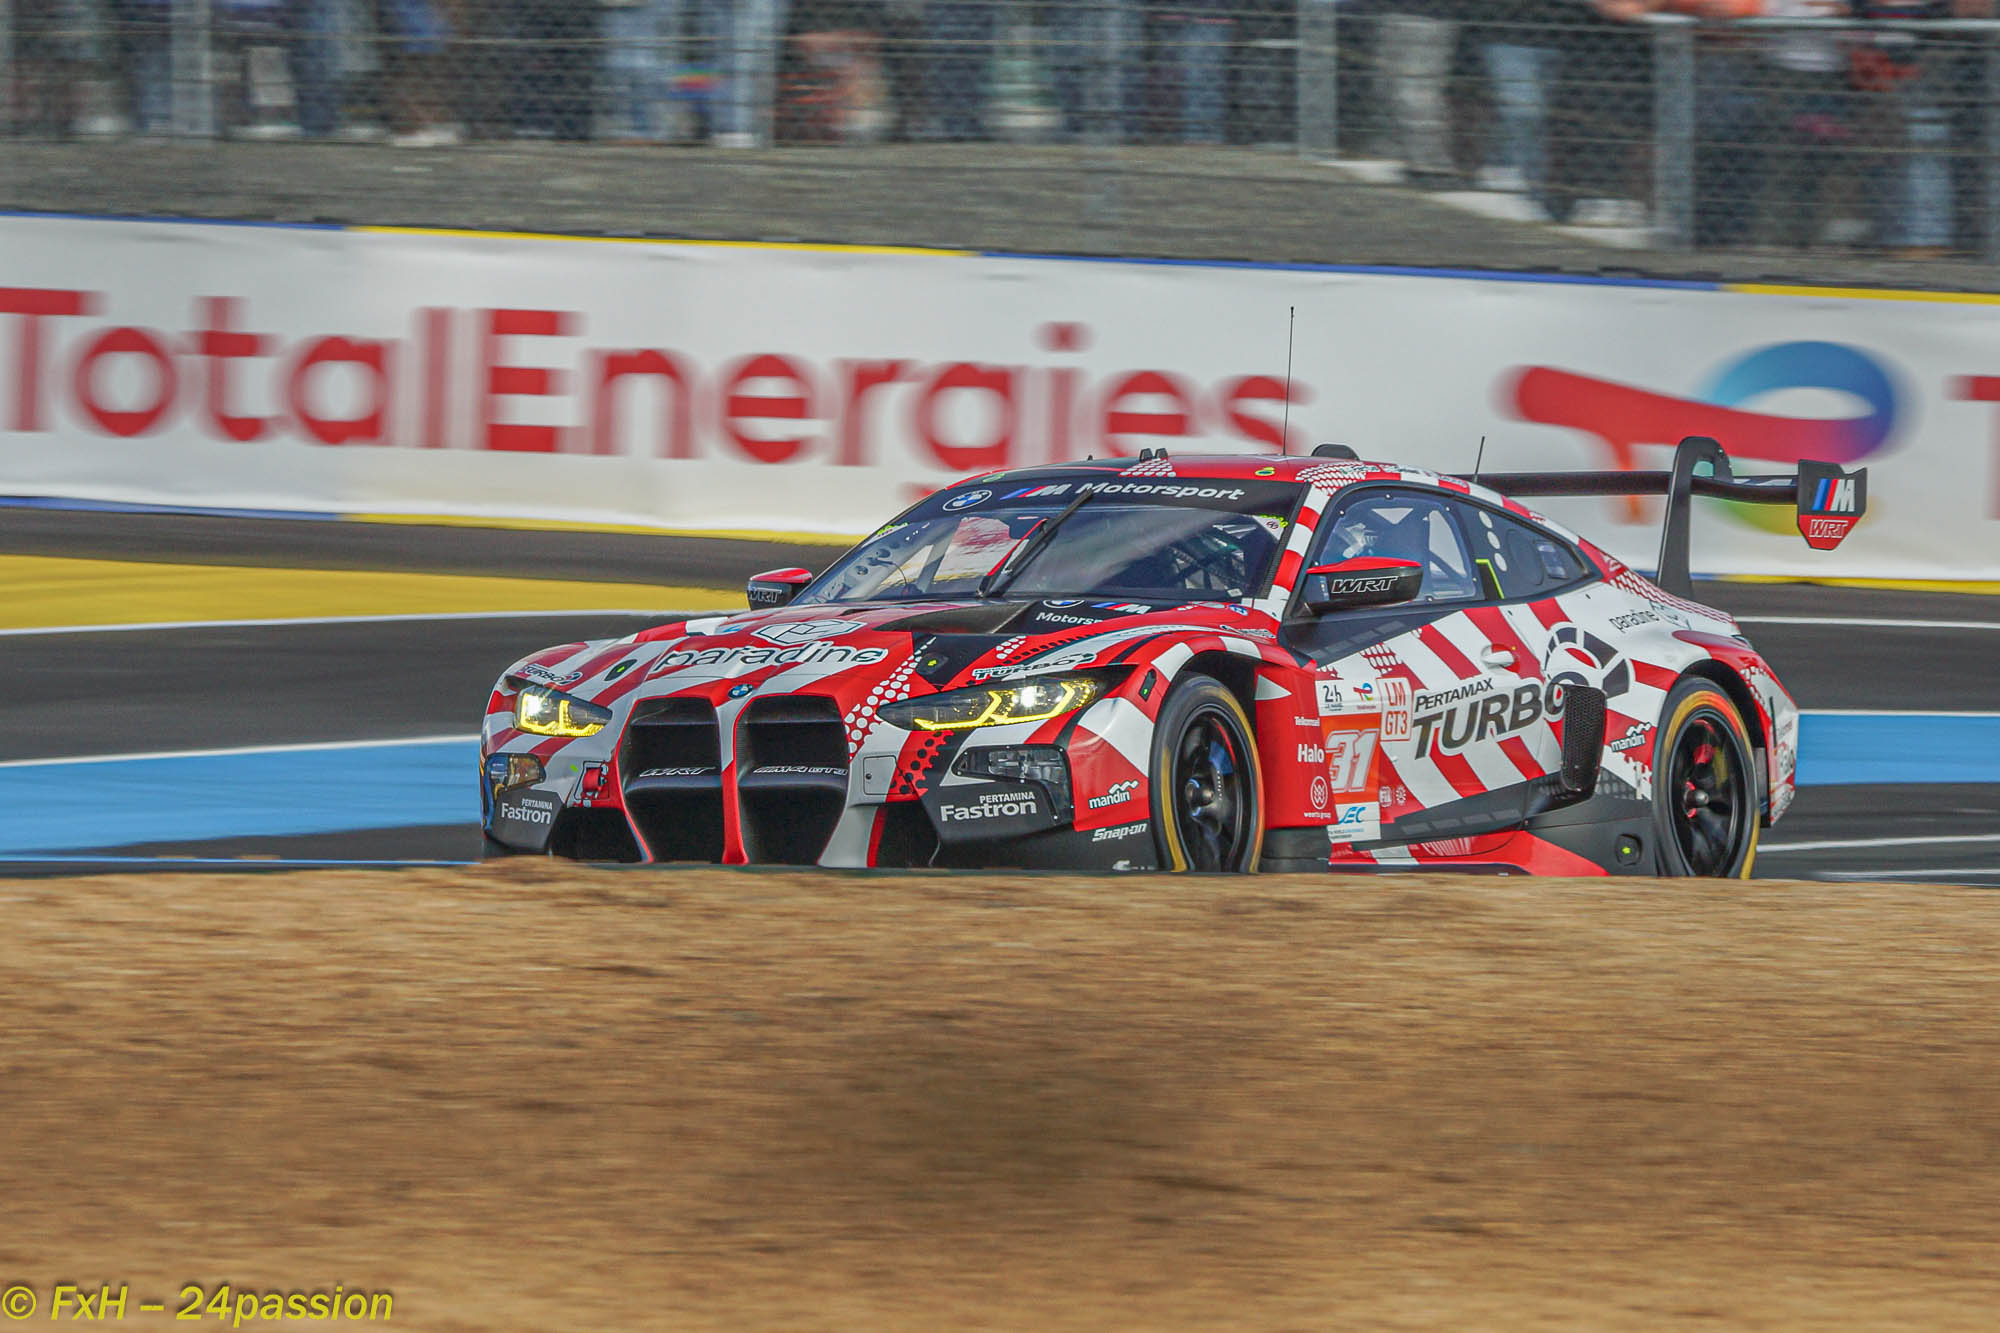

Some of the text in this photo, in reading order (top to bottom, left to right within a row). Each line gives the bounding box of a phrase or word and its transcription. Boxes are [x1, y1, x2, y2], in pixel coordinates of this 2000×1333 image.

[1075, 482, 1245, 501] Motorsport
[1808, 518, 1850, 540] WRT
[750, 586, 783, 603] WRT
[1331, 575, 1399, 594] WRT
[1608, 609, 1660, 634] paradine
[652, 639, 889, 673] paradine
[1322, 685, 1343, 703] 24h
[1384, 681, 1406, 707] LM
[1414, 677, 1495, 713] PERTAMAX
[1384, 710, 1408, 736] GT3
[1297, 743, 1326, 763] Halo
[1324, 728, 1381, 794] 31
[979, 791, 1036, 804] PERTAMINA
[501, 802, 552, 825] Fastron
[940, 799, 1037, 822] Fastron
[1092, 822, 1147, 842] Snap-on
